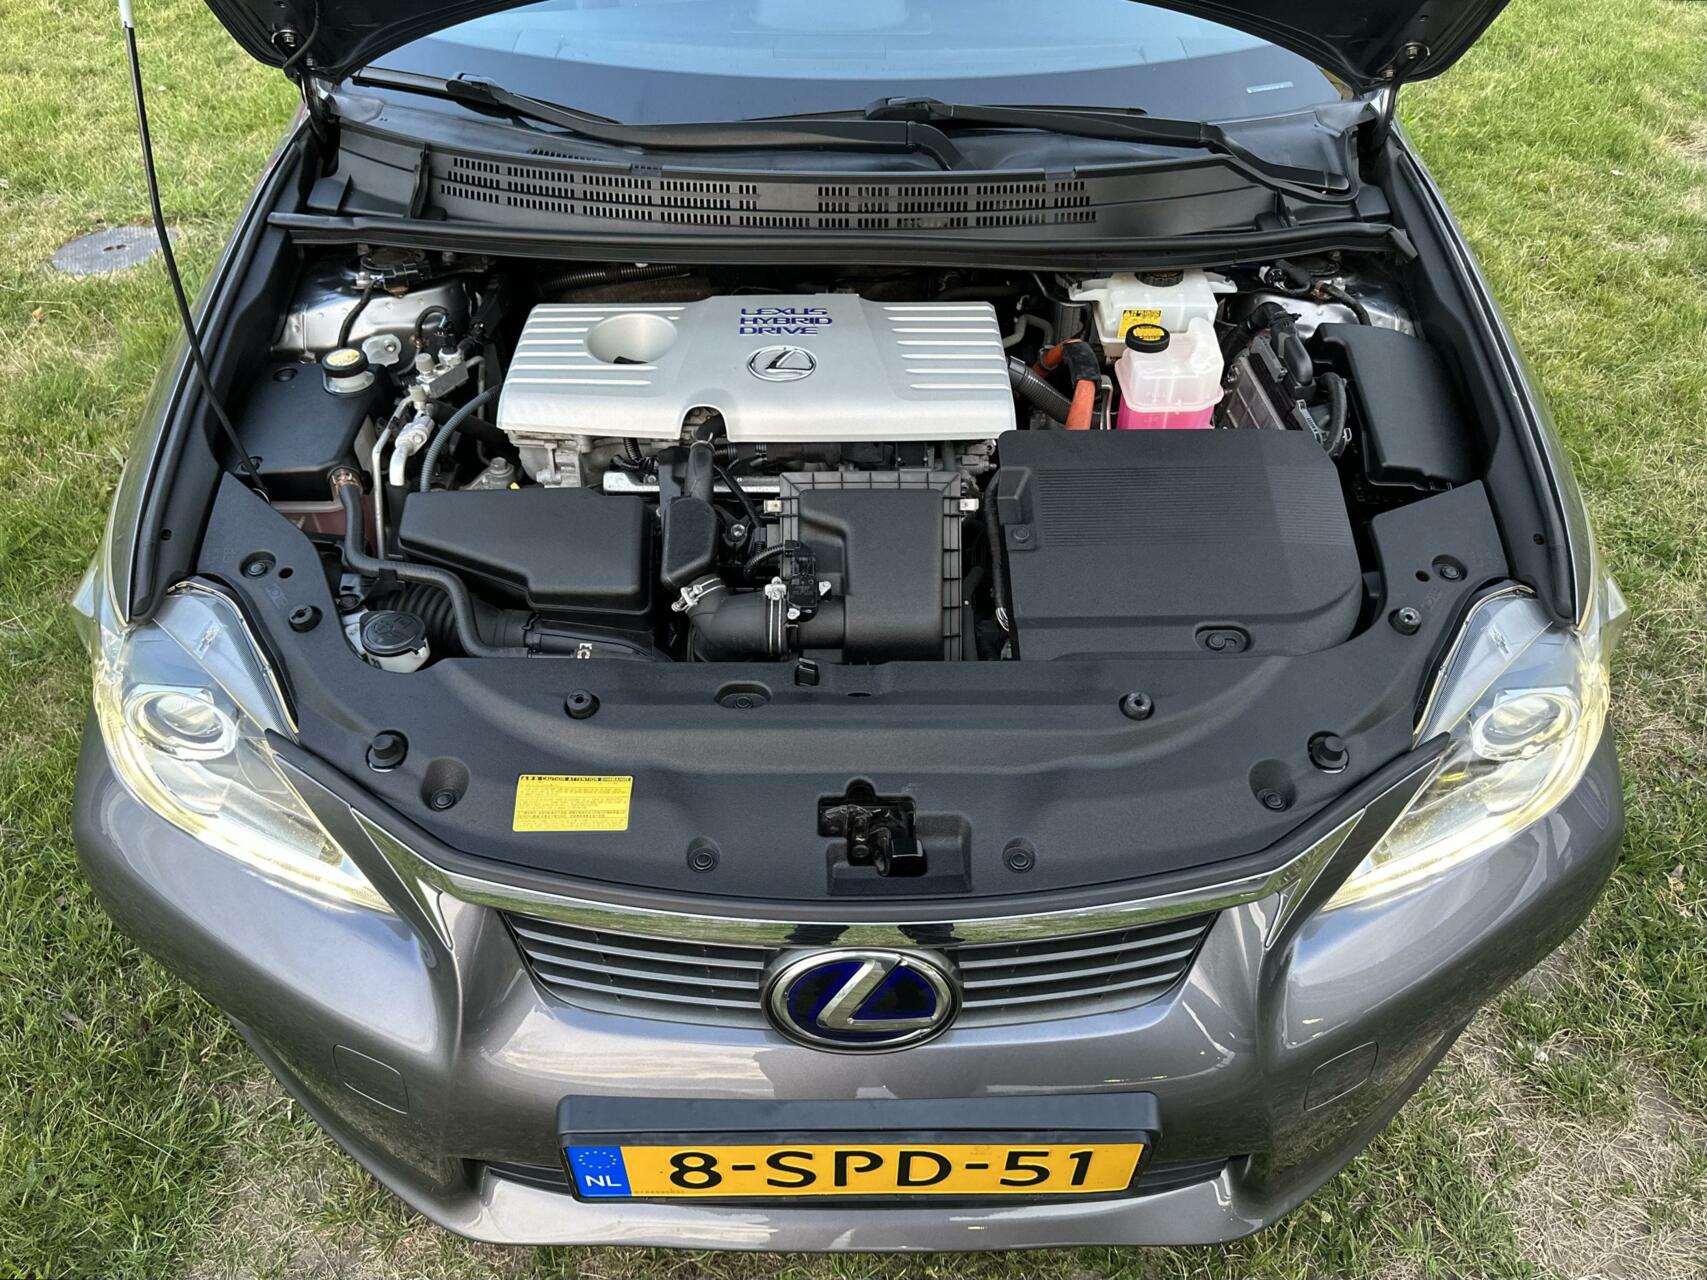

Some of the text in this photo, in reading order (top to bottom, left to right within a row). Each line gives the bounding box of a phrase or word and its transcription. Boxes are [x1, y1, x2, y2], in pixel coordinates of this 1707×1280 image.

[740, 317, 833, 325] HYBRID
[739, 327, 818, 335] DRIVE
[669, 1150, 1094, 1190] 8-SPD-51
[585, 1174, 622, 1188] NL
